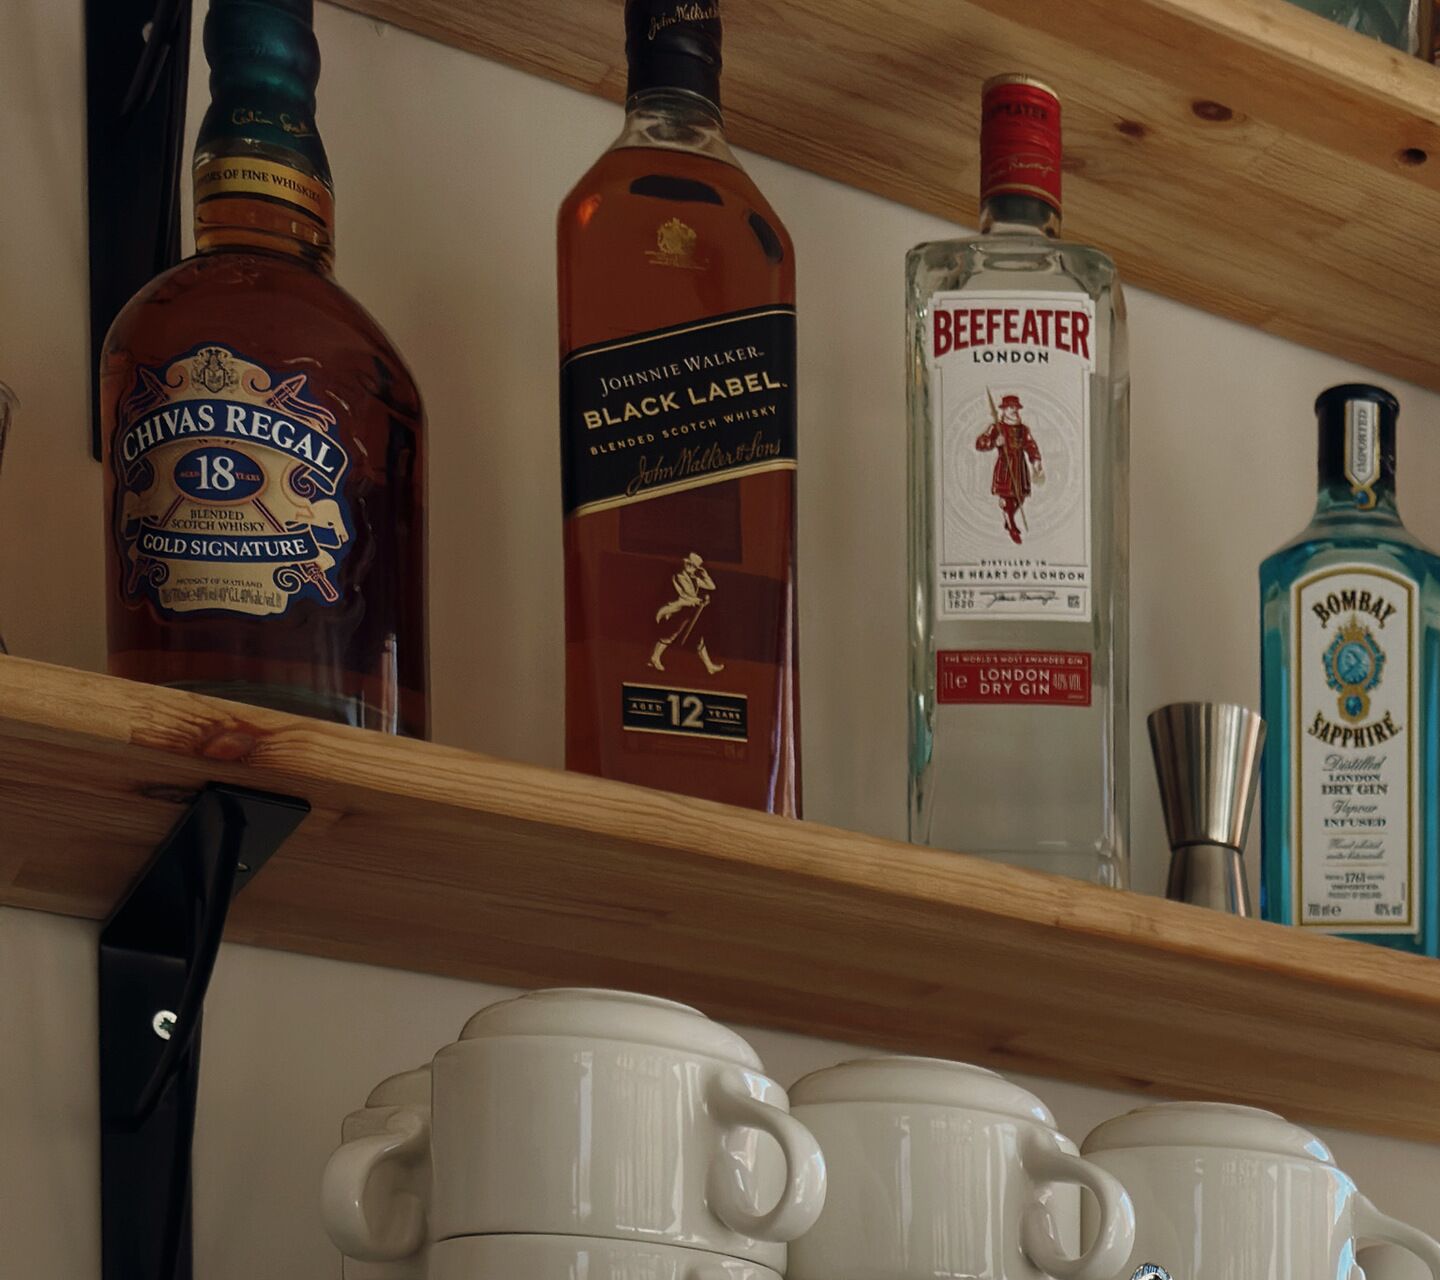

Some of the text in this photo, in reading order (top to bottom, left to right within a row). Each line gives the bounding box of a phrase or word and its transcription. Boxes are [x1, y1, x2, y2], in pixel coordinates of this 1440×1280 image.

[224, 169, 239, 180] OF
[242, 169, 269, 182] FINE
[933, 309, 1090, 360] BEEFEATER
[973, 351, 1049, 364] LONDON
[600, 345, 760, 397] JOHNNIE WALKER
[583, 371, 782, 430] BLACK LABEL
[123, 404, 334, 473] CHIVAS REGAL
[590, 404, 778, 456] BLENDED SCOTCH WHISKY
[196, 455, 236, 491] 18
[190, 509, 244, 520] BLENDED
[170, 518, 265, 532] SCOTCH WHISKY
[143, 534, 308, 558] GOLD SIGNATURE
[942, 571, 1085, 581] THE HEART OF LONDON
[1312, 589, 1397, 630] BOMBAY
[980, 669, 1050, 681] LONDON
[981, 684, 1050, 695] DRY GIN
[667, 694, 704, 728] 12
[1308, 710, 1400, 748] SAPPHIRE
[1322, 754, 1387, 771] Distilled
[1321, 784, 1388, 796] DRY GIN
[1324, 819, 1387, 827] INFUSED
